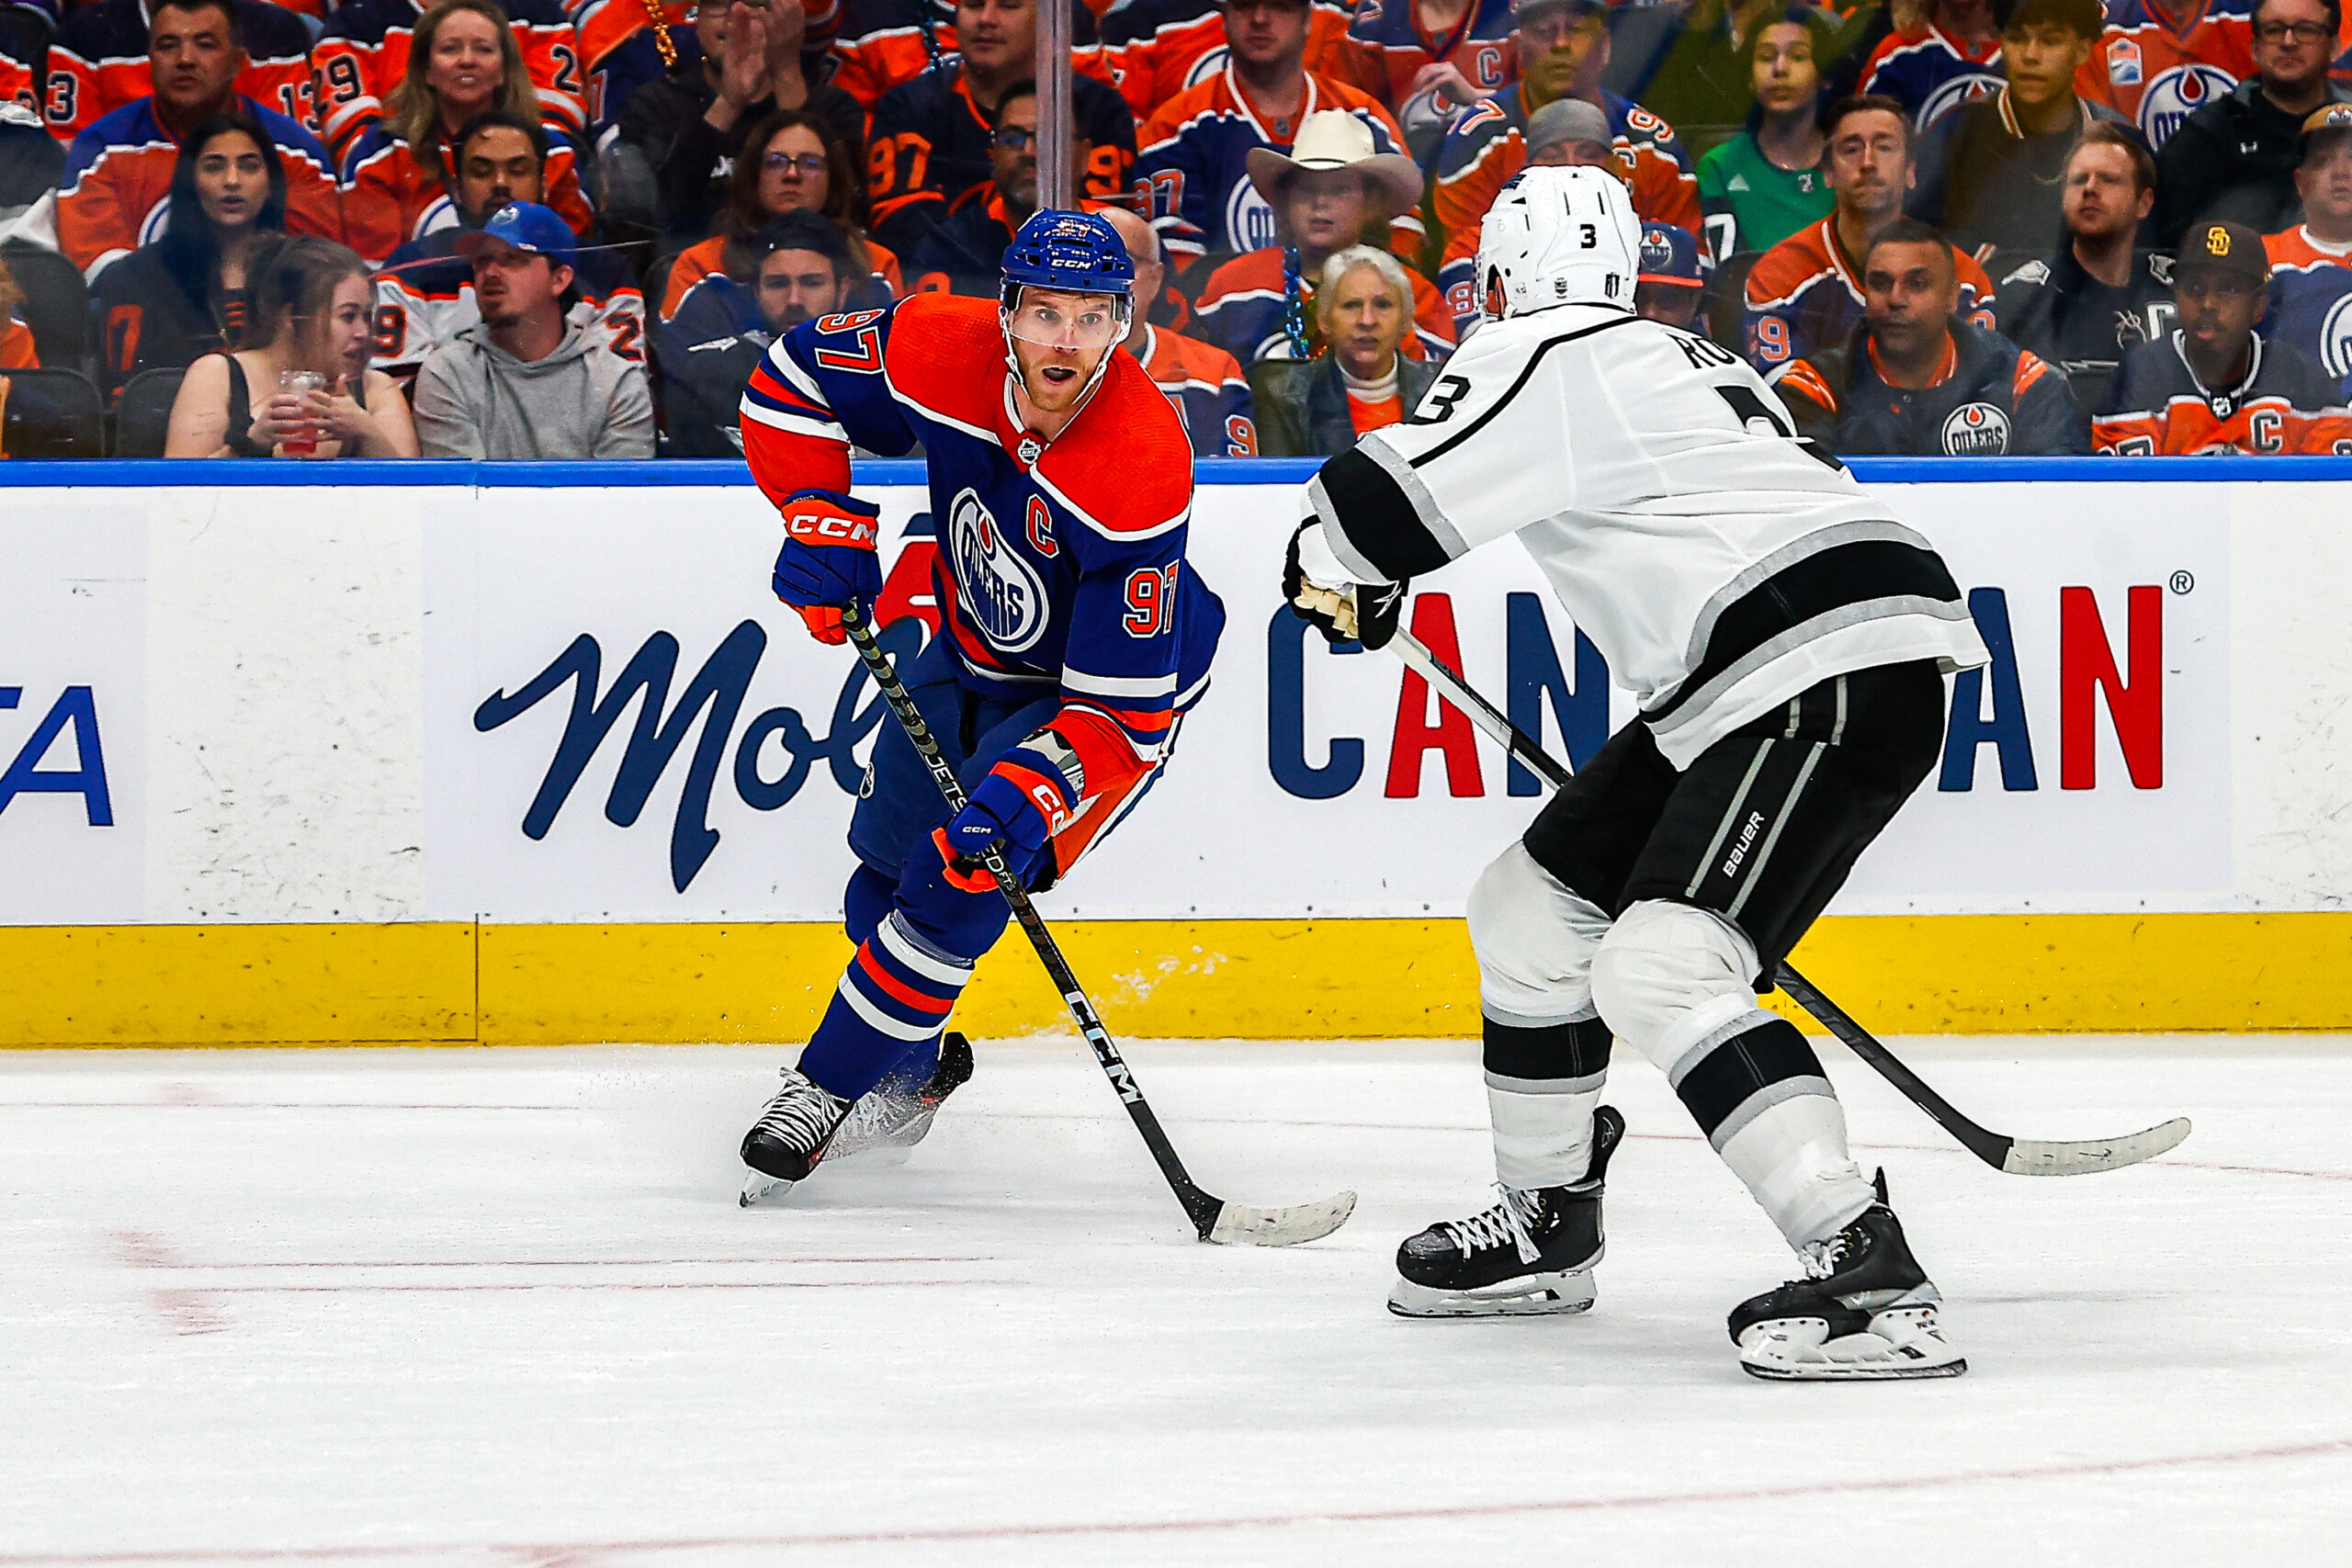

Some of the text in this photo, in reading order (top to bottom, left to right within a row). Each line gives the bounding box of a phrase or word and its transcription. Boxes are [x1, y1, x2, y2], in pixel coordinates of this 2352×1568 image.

[550, 43, 582, 95] 2
[1476, 47, 1503, 88] C
[46, 70, 78, 125] 3
[868, 131, 933, 198] 97
[1579, 223, 1597, 249] 3
[1050, 258, 1092, 270] CCM
[814, 308, 887, 376] 97
[1410, 374, 1472, 425] 3
[2250, 410, 2283, 453] C
[789, 514, 876, 546] CCM
[1025, 492, 1060, 559] C
[1122, 558, 1181, 638] 97
[962, 826, 992, 834] CCM
[1722, 810, 1765, 878] BAUER
[1065, 990, 1145, 1104] CCM
